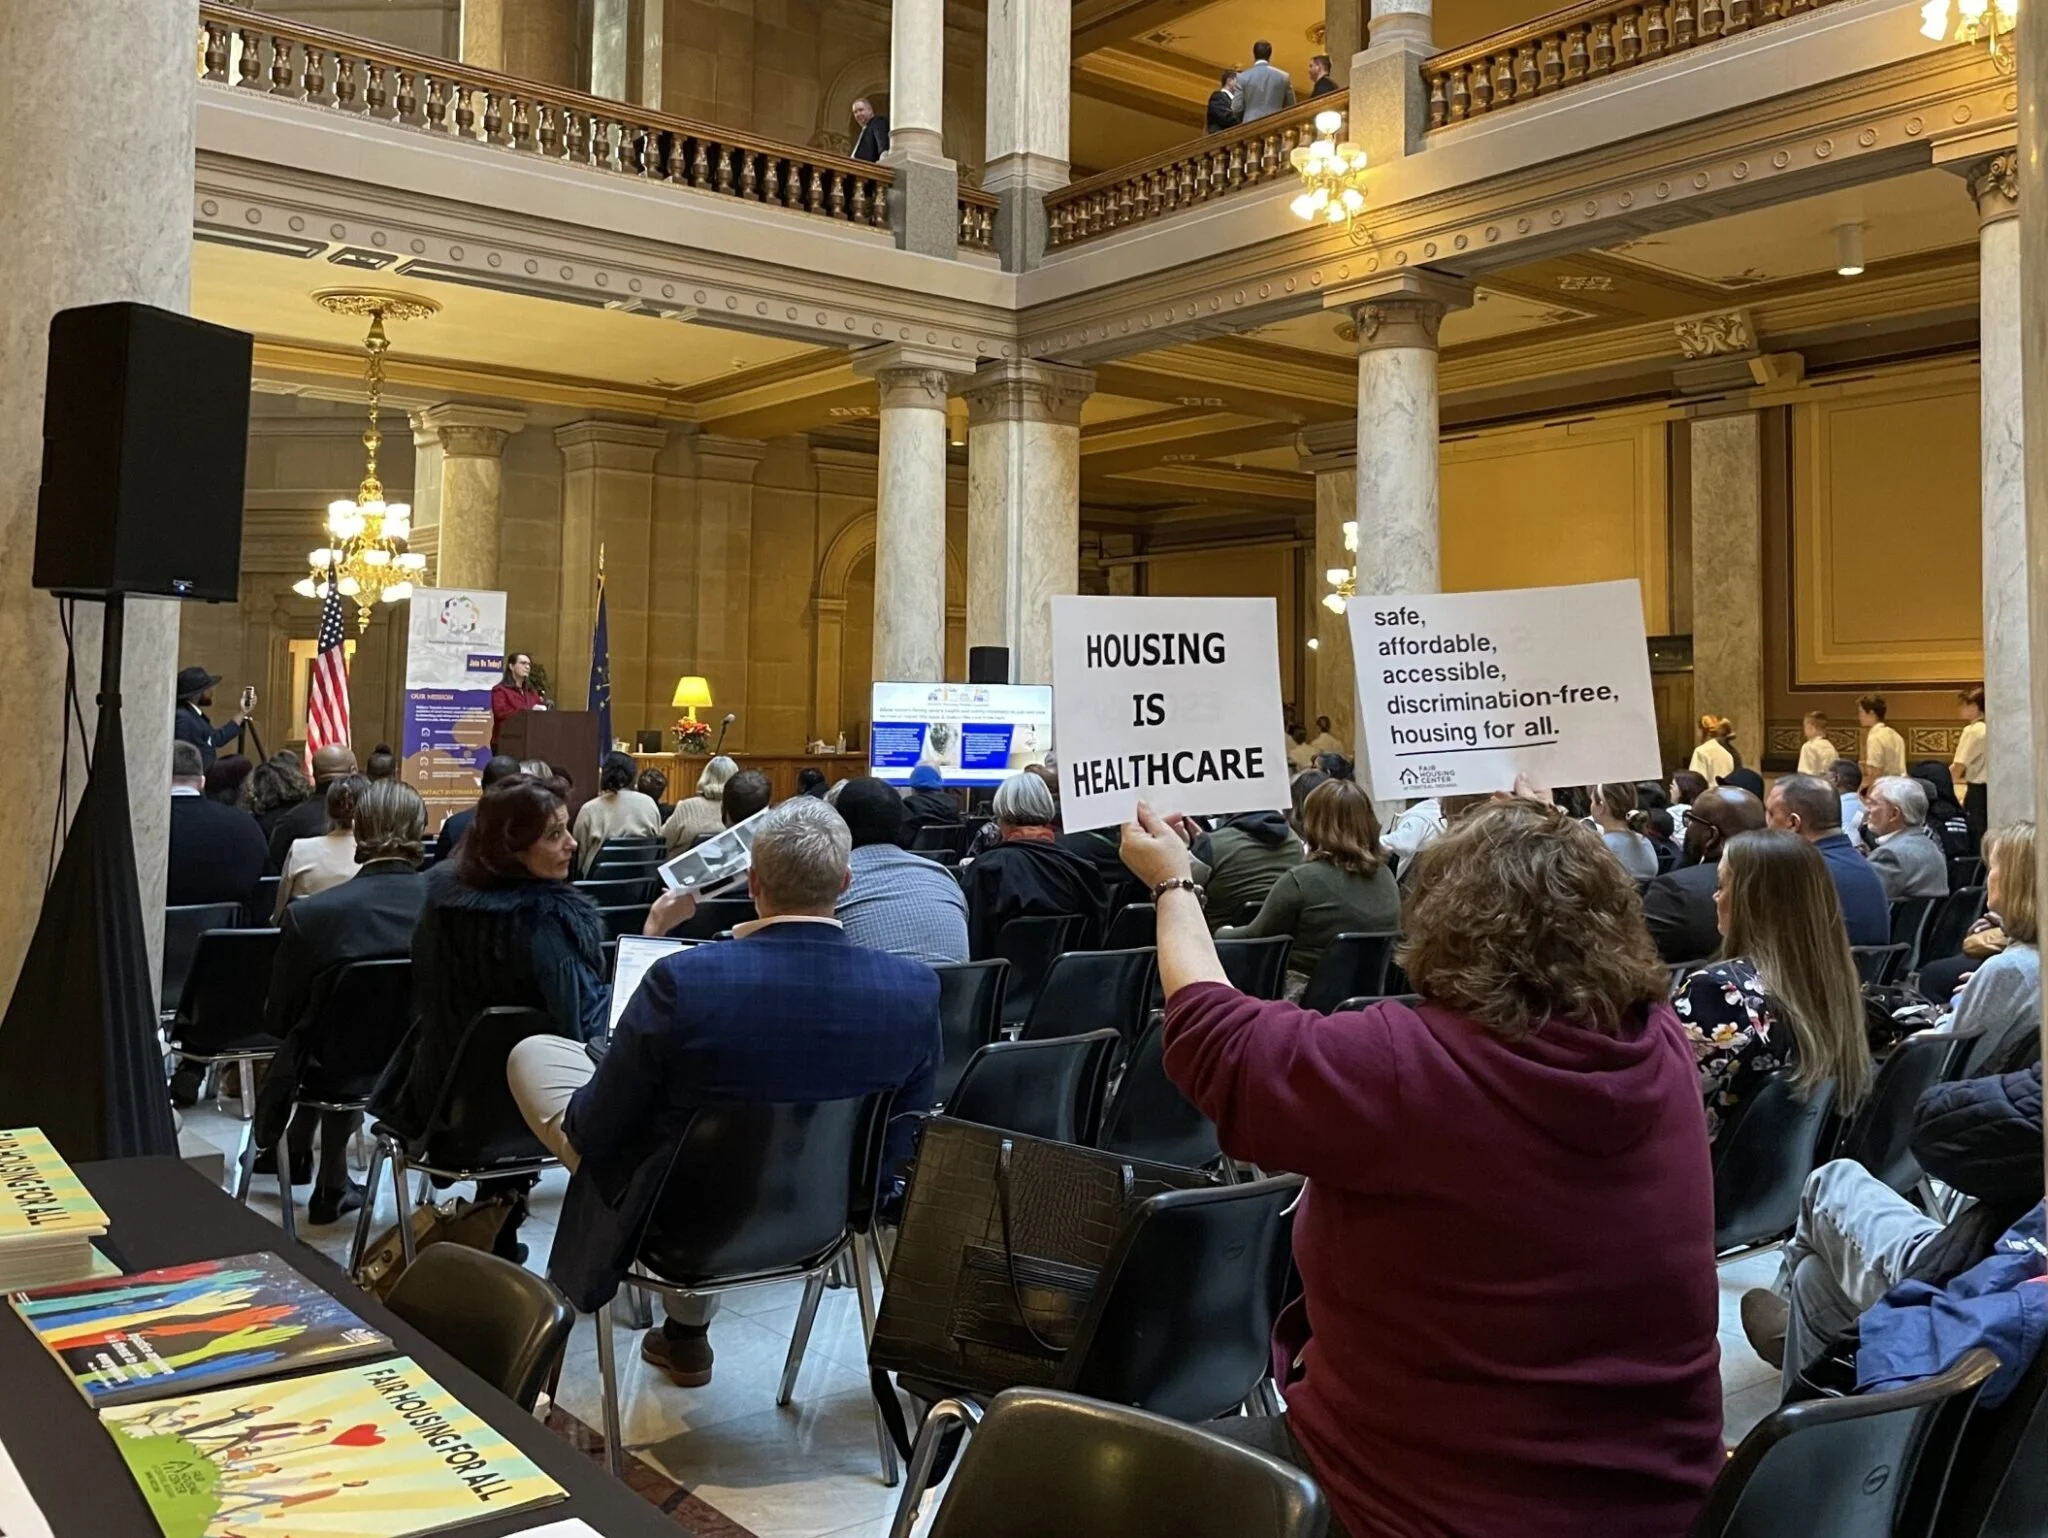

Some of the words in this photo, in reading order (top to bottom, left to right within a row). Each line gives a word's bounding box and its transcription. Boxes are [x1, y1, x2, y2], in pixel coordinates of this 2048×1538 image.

[1374, 607, 1426, 628] safe,
[1087, 632, 1226, 668] HOUSING
[1378, 633, 1497, 656] affordable,
[1383, 661, 1507, 684] accessible,
[1133, 693, 1166, 727] IS
[1387, 685, 1619, 715] discrimination-free,
[1391, 723, 1477, 746] housing
[1484, 720, 1515, 739] for
[1524, 716, 1560, 737] all.
[1073, 747, 1265, 797] HEALTHCARE
[10, 1186, 58, 1207] FOR
[21, 1207, 71, 1226] ALL
[363, 1368, 410, 1396] FAIR
[386, 1391, 462, 1448] HOUSING
[435, 1442, 487, 1475] FOR
[461, 1472, 513, 1502] ALL
